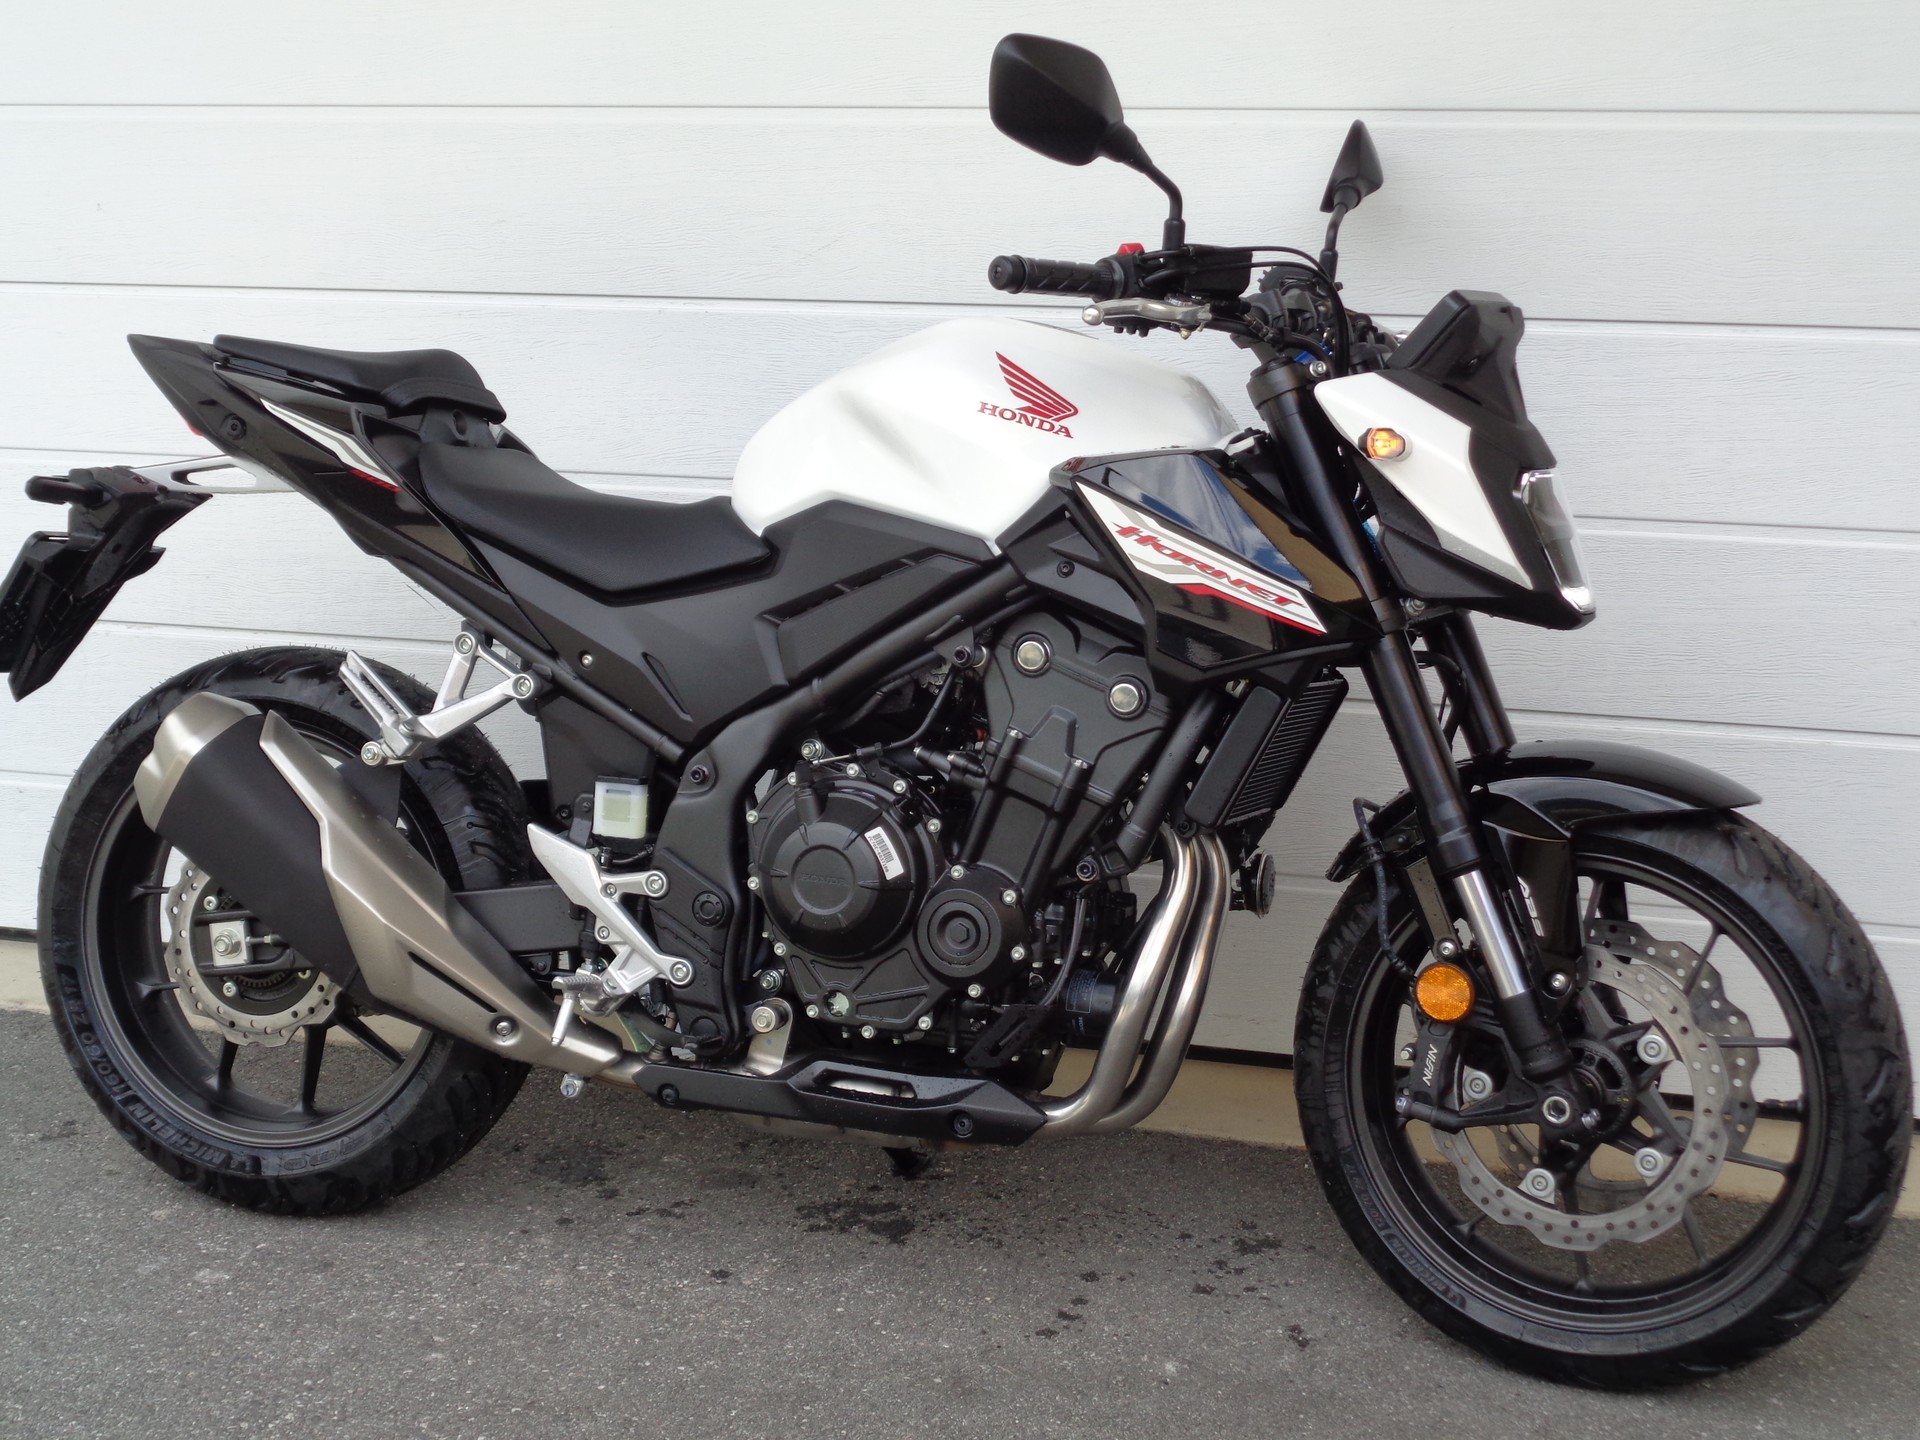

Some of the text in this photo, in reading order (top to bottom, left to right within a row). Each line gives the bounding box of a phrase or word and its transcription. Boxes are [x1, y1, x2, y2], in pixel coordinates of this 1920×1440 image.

[977, 401, 1074, 439] HONDA
[1111, 521, 1307, 608] HORNET
[1516, 875, 1545, 937] ABS
[80, 1032, 126, 1093] 160/60
[128, 1102, 227, 1165] MICHELIN
[1388, 1236, 1448, 1291] MICHELIN
